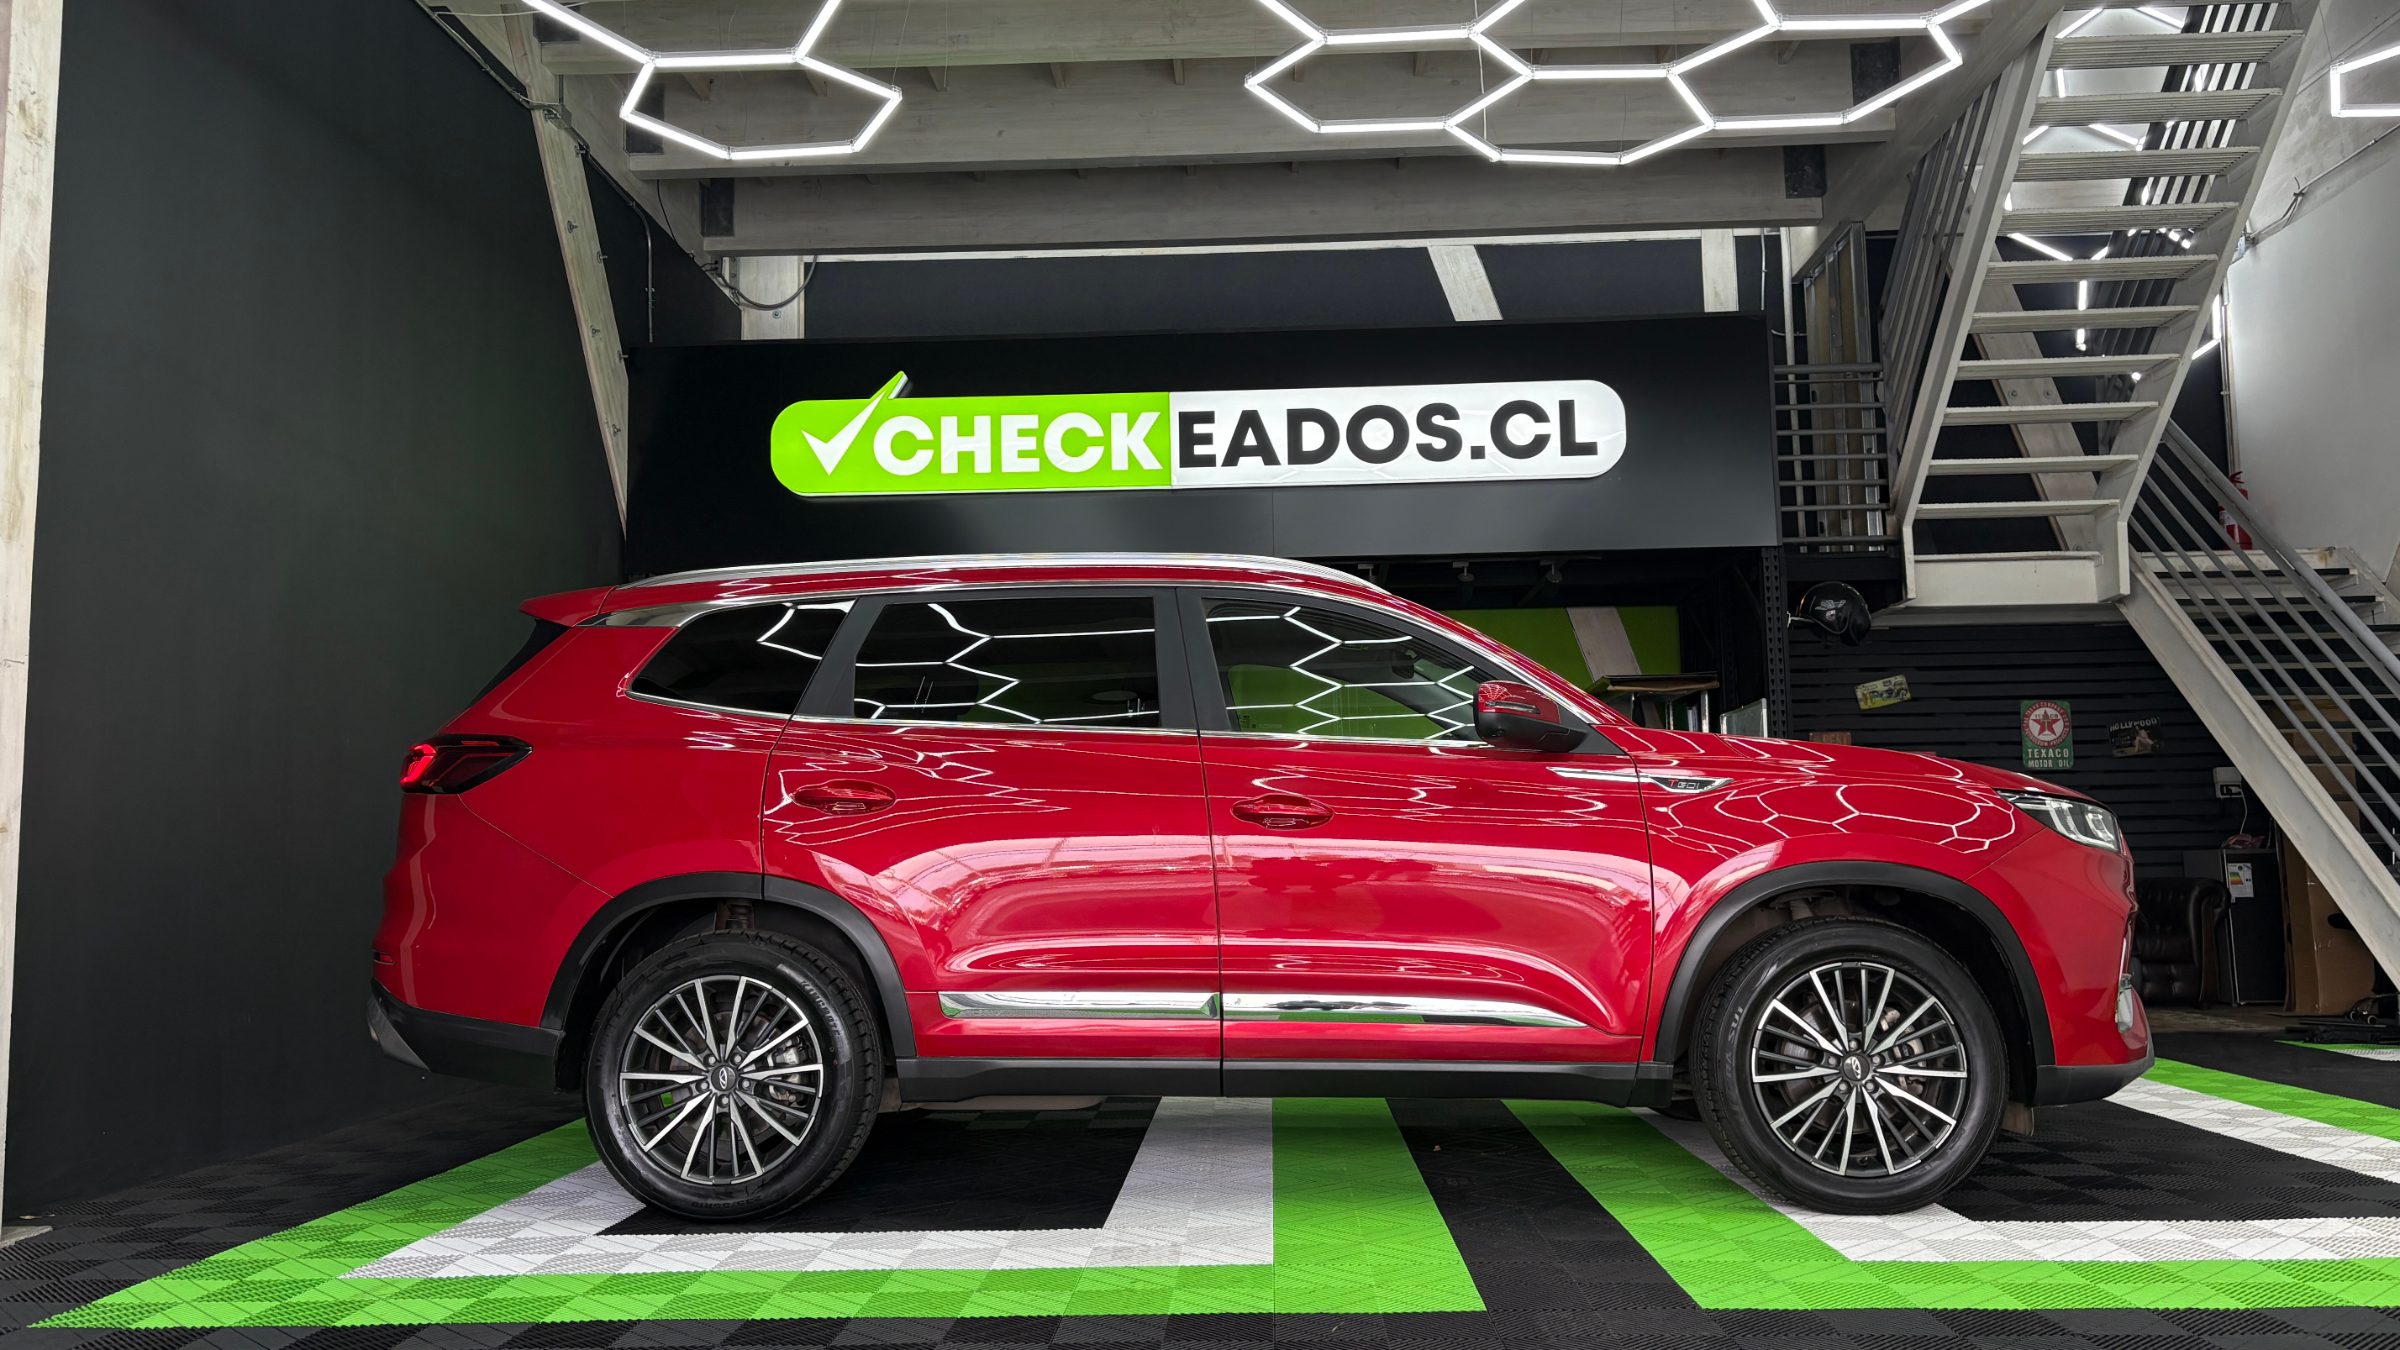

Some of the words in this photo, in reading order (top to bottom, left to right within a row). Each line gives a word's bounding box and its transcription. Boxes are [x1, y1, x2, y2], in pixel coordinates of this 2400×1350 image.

[873, 399, 1598, 476] CHECKEADOS.CL
[2109, 717, 2157, 732] HOLLYWOOD
[2027, 748, 2069, 758] TEXACO
[2027, 759, 2053, 768] MOTOR
[2058, 759, 2070, 768] OIL
